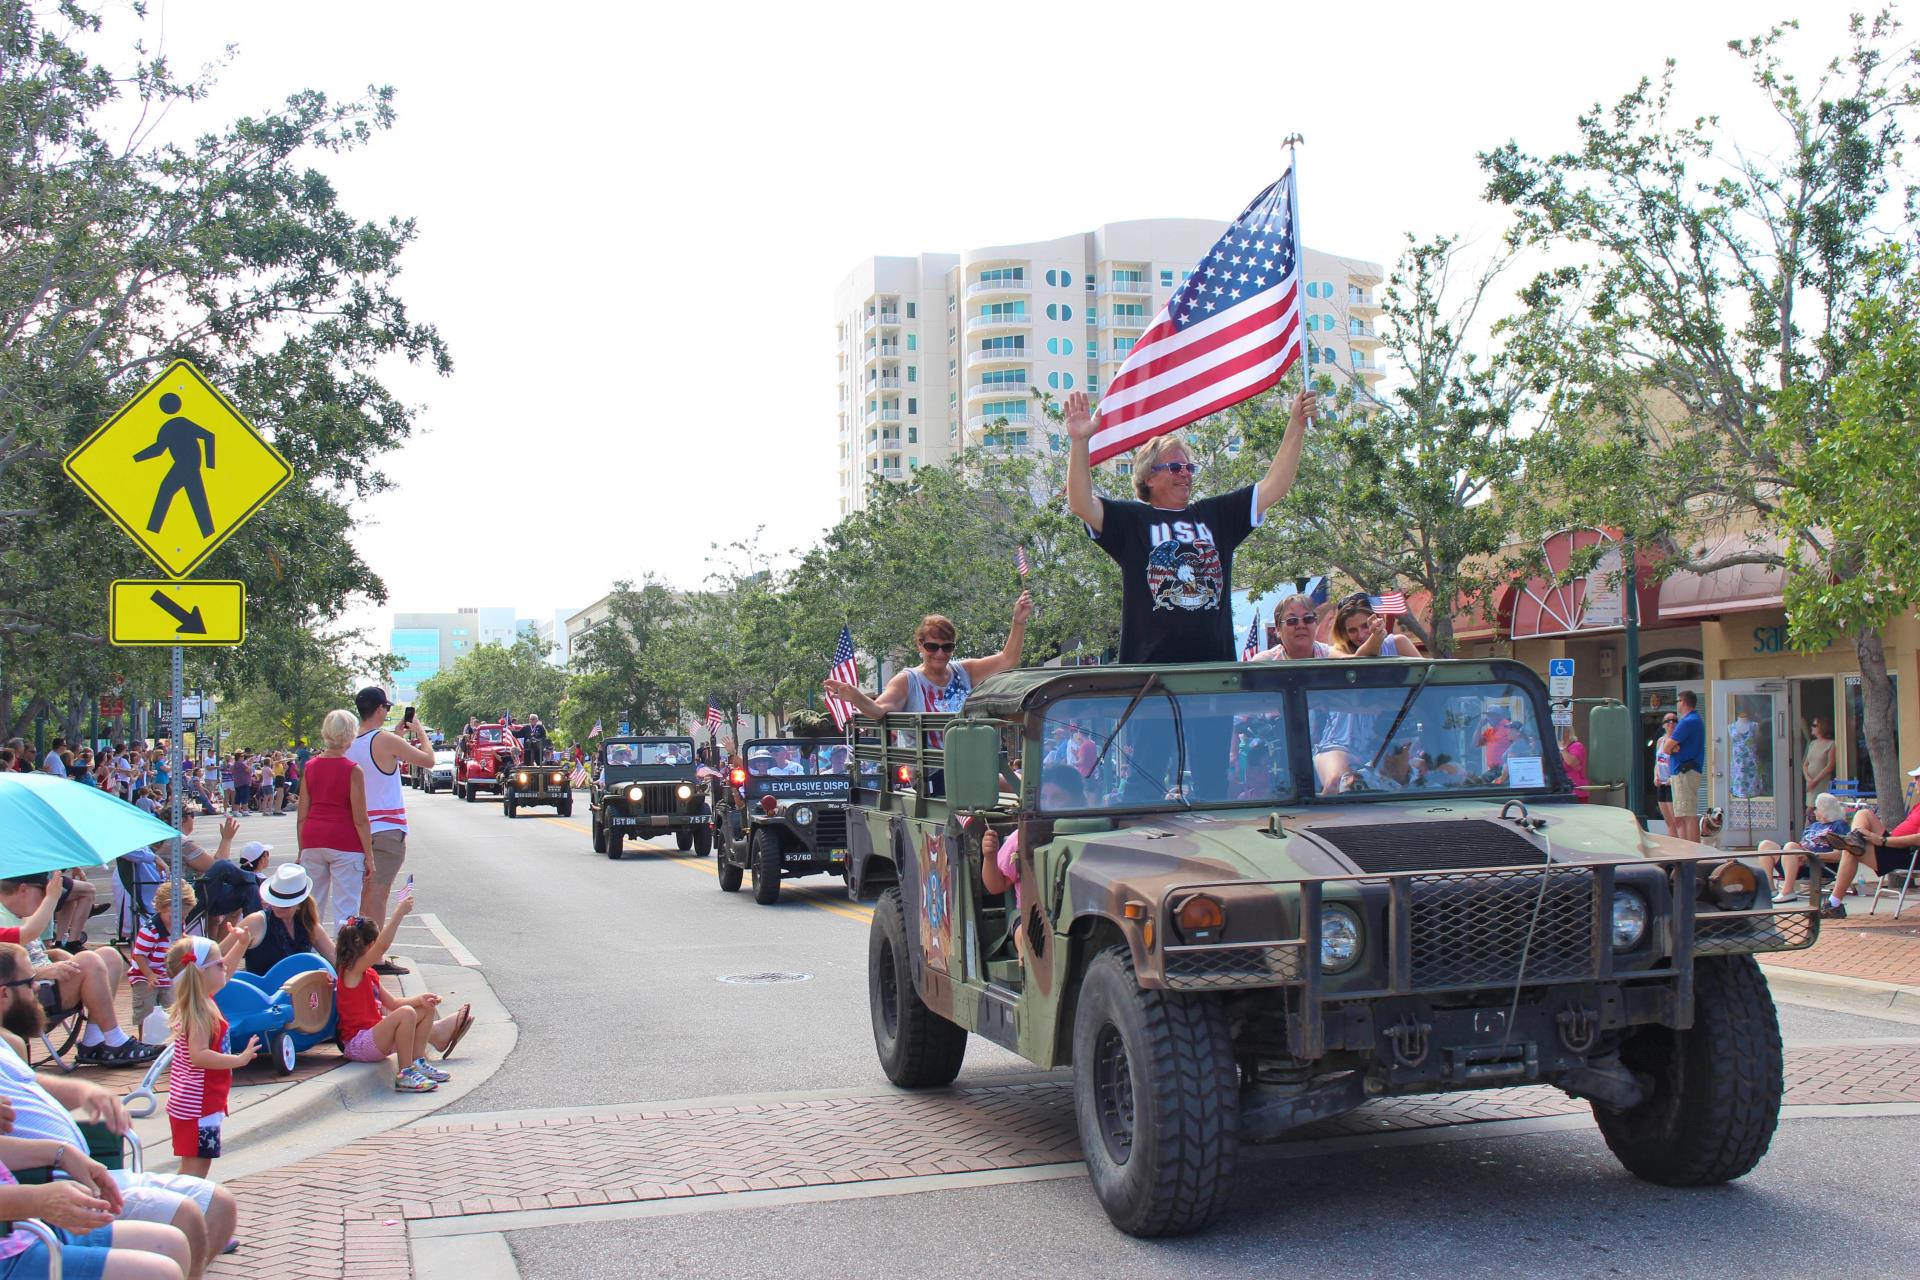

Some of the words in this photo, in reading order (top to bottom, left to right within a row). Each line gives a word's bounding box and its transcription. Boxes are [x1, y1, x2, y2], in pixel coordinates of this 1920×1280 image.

[1151, 521, 1215, 546] USA
[772, 782, 821, 792] EXPLOSIVE
[824, 782, 849, 790] DISPO
